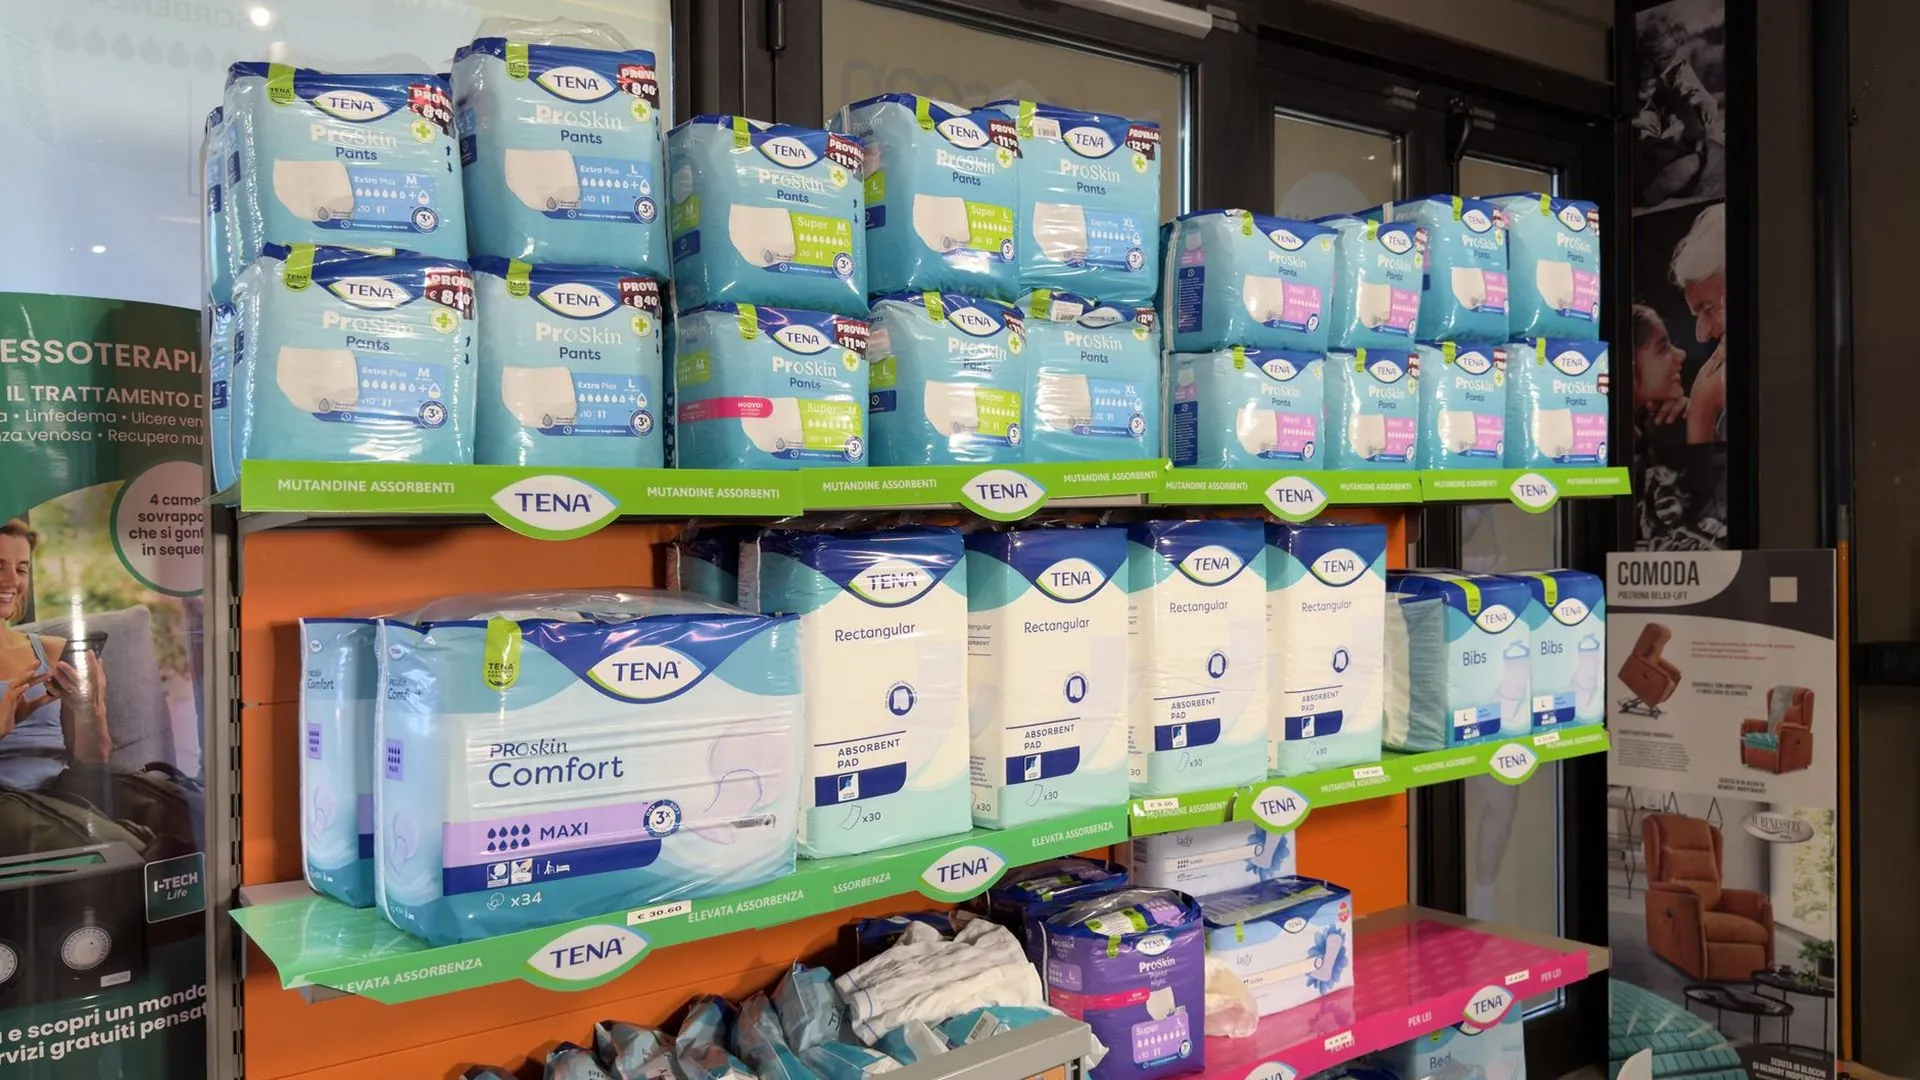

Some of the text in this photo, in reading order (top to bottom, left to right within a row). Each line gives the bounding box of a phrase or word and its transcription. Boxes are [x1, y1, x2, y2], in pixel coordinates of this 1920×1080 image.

[553, 74, 599, 91] TENA
[631, 82, 656, 98] 8,40
[328, 97, 375, 112] TENA
[535, 105, 626, 132] ProSkin
[310, 123, 398, 148] ProSkin
[560, 129, 603, 145] Pants
[948, 124, 980, 140] TENA
[1074, 133, 1104, 148] TENA
[336, 147, 378, 161] Pants
[772, 143, 807, 159] TENA
[580, 165, 620, 175] Extra Plus
[1060, 159, 1121, 183] ProSkin
[952, 171, 982, 186] Pants
[1076, 181, 1107, 196] Pants
[776, 190, 809, 205] Pants
[970, 205, 996, 218] Super
[797, 216, 828, 231] Super
[1123, 218, 1136, 228] XL
[1268, 250, 1308, 269] ProSkin
[347, 283, 395, 299] TENA
[430, 290, 437, 300] €
[553, 292, 601, 307] TENA
[623, 295, 657, 310] € 8,40
[960, 313, 993, 328] TENA
[535, 322, 623, 345] ProSkin
[785, 332, 820, 345] TENA
[1063, 331, 1123, 351] ProSkin
[346, 335, 390, 351] Pants
[559, 346, 601, 360] Pants
[1080, 351, 1109, 363] Pants
[772, 356, 837, 378] ProSkin
[1269, 365, 1291, 375] TENA
[1463, 357, 1485, 368] TENA
[1561, 357, 1583, 368] TENA
[1377, 366, 1397, 376] TENA
[789, 377, 821, 390] Pants
[1124, 385, 1136, 395] XL
[1261, 383, 1301, 397] ProSkin
[1368, 384, 1405, 398] ProSkin
[1455, 376, 1494, 393] ProSkin
[1552, 379, 1598, 395] ProSkin
[6, 385, 25, 402] IL
[30, 385, 190, 408] TRATTAMENTO
[25, 409, 117, 423] Linfedema
[131, 411, 177, 427] Ulcere
[28, 430, 93, 442] venosa
[107, 429, 179, 447] Recupero
[1063, 469, 1158, 483] MUTANDINE ASSORBENTI
[278, 478, 455, 494] MUTANDINE ASSORBENTI
[647, 485, 780, 499] MUTANDINE ASSORBENTI
[822, 477, 937, 492] MUTANDINE ASSORBENTI
[976, 482, 1029, 500] TENA
[1208, 481, 1248, 491] ASSORBENTI
[1518, 484, 1548, 497] TENA
[149, 493, 159, 506] 4
[514, 492, 592, 513] TENA
[1276, 488, 1314, 503] TENA
[128, 526, 157, 540] che
[160, 526, 172, 540] si
[142, 543, 156, 556] in
[1194, 556, 1230, 572] TENA
[1323, 560, 1355, 574] TENA
[1051, 571, 1091, 588] TENA
[1617, 560, 1700, 587] COMODA
[866, 572, 918, 591] TENA
[1618, 591, 1649, 600] POLTRONA
[1169, 600, 1229, 615] Rectangular
[1301, 600, 1353, 614] Rectangular
[1559, 606, 1582, 618] TENA
[1023, 617, 1090, 634] Rectangular
[1484, 612, 1508, 625] TENA
[834, 622, 916, 642] Rectangular
[1540, 640, 1564, 656] Bibs
[1462, 650, 1487, 667] Bibs
[612, 660, 679, 682] TENA
[307, 678, 335, 691] Comfort
[1171, 697, 1216, 711] ABSORBENT
[1302, 690, 1339, 703] ABSORBENT
[1170, 711, 1187, 720] PAD
[1301, 703, 1315, 713] PAD
[1024, 724, 1075, 740] ABSORBENT
[489, 738, 569, 758] PROskin
[837, 738, 900, 758] ABSORBENT
[1023, 740, 1042, 751] PAD
[837, 757, 860, 770] PAD
[1497, 753, 1528, 769] TENA
[488, 755, 624, 789] Comfort
[1043, 790, 1059, 802] x30
[1260, 797, 1296, 816] TENA
[861, 811, 881, 824] x30
[540, 822, 589, 842] MAXI
[1032, 820, 1114, 848] ELEVATA ASSORBENZA
[937, 857, 988, 883] TENA
[153, 872, 198, 892] I-TECH
[166, 888, 188, 901] Life
[510, 891, 543, 908] x34
[637, 905, 683, 921] € 30.60
[687, 889, 806, 924] ELEVATA ASSORBENZA
[1143, 939, 1165, 950] TENA
[549, 937, 623, 969] TENA
[1139, 956, 1176, 974] ProSkin
[1473, 994, 1502, 1015] TENA
[8, 1028, 22, 1041] e
[27, 1008, 100, 1036] scopri
[105, 1005, 134, 1021] un
[1407, 1012, 1422, 1028] PER
[1135, 1024, 1160, 1035] Super
[50, 1021, 135, 1060] gratuiti
[1429, 1053, 1451, 1070] Bed
